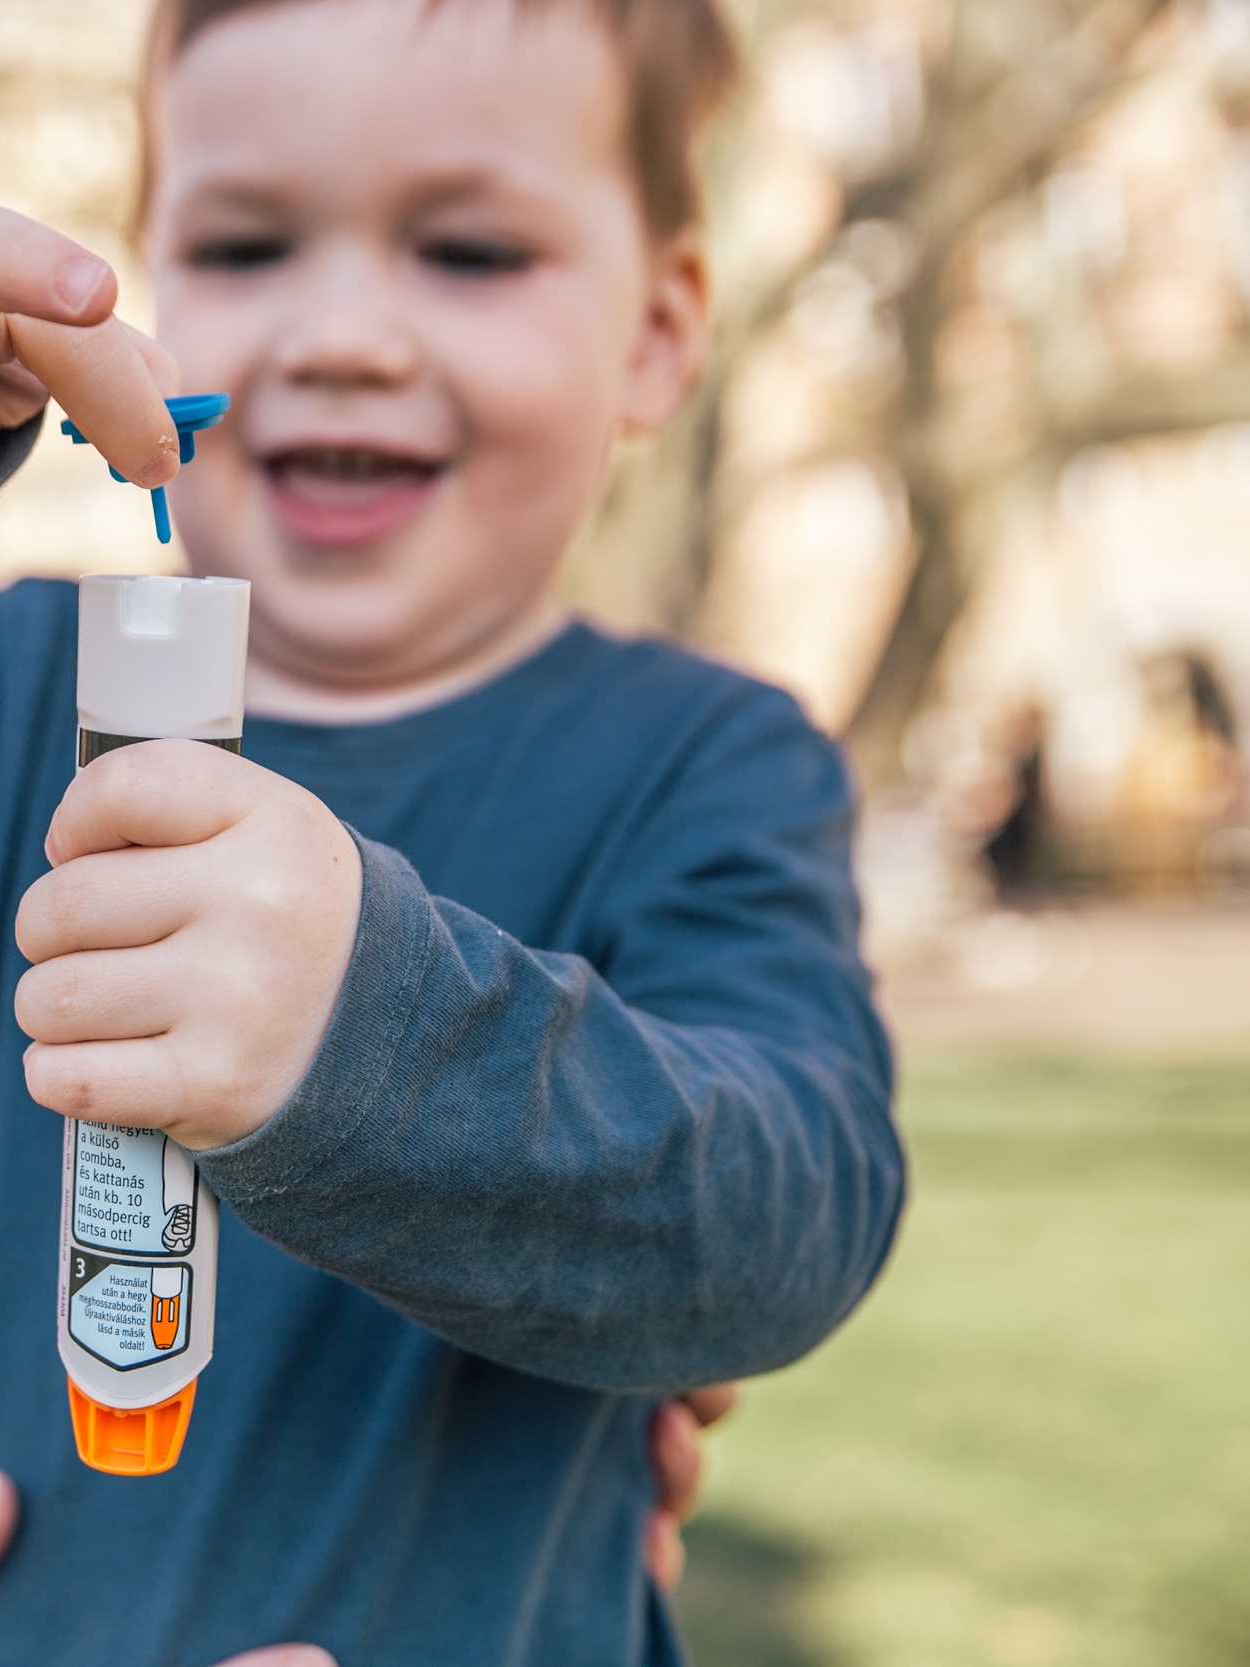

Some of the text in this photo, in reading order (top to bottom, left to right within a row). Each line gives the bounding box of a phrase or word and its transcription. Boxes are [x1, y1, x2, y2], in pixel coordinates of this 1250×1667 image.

[81, 1131, 120, 1150] a külső
[80, 1150, 126, 1171] combba,
[79, 1165, 145, 1189] és kattanás
[79, 1185, 143, 1207] után kb. 10
[78, 1202, 151, 1228] másodpercig
[77, 1219, 132, 1242] tartsa ott!
[75, 1257, 86, 1279] 3
[109, 1275, 148, 1288] Használat
[79, 1294, 147, 1314] meghosszabbodik.
[101, 1287, 148, 1302] után a hegy
[84, 1305, 146, 1326] Újraaktiváláshoz
[97, 1323, 146, 1338] lásd a másik
[119, 1340, 145, 1351] oldalt!
